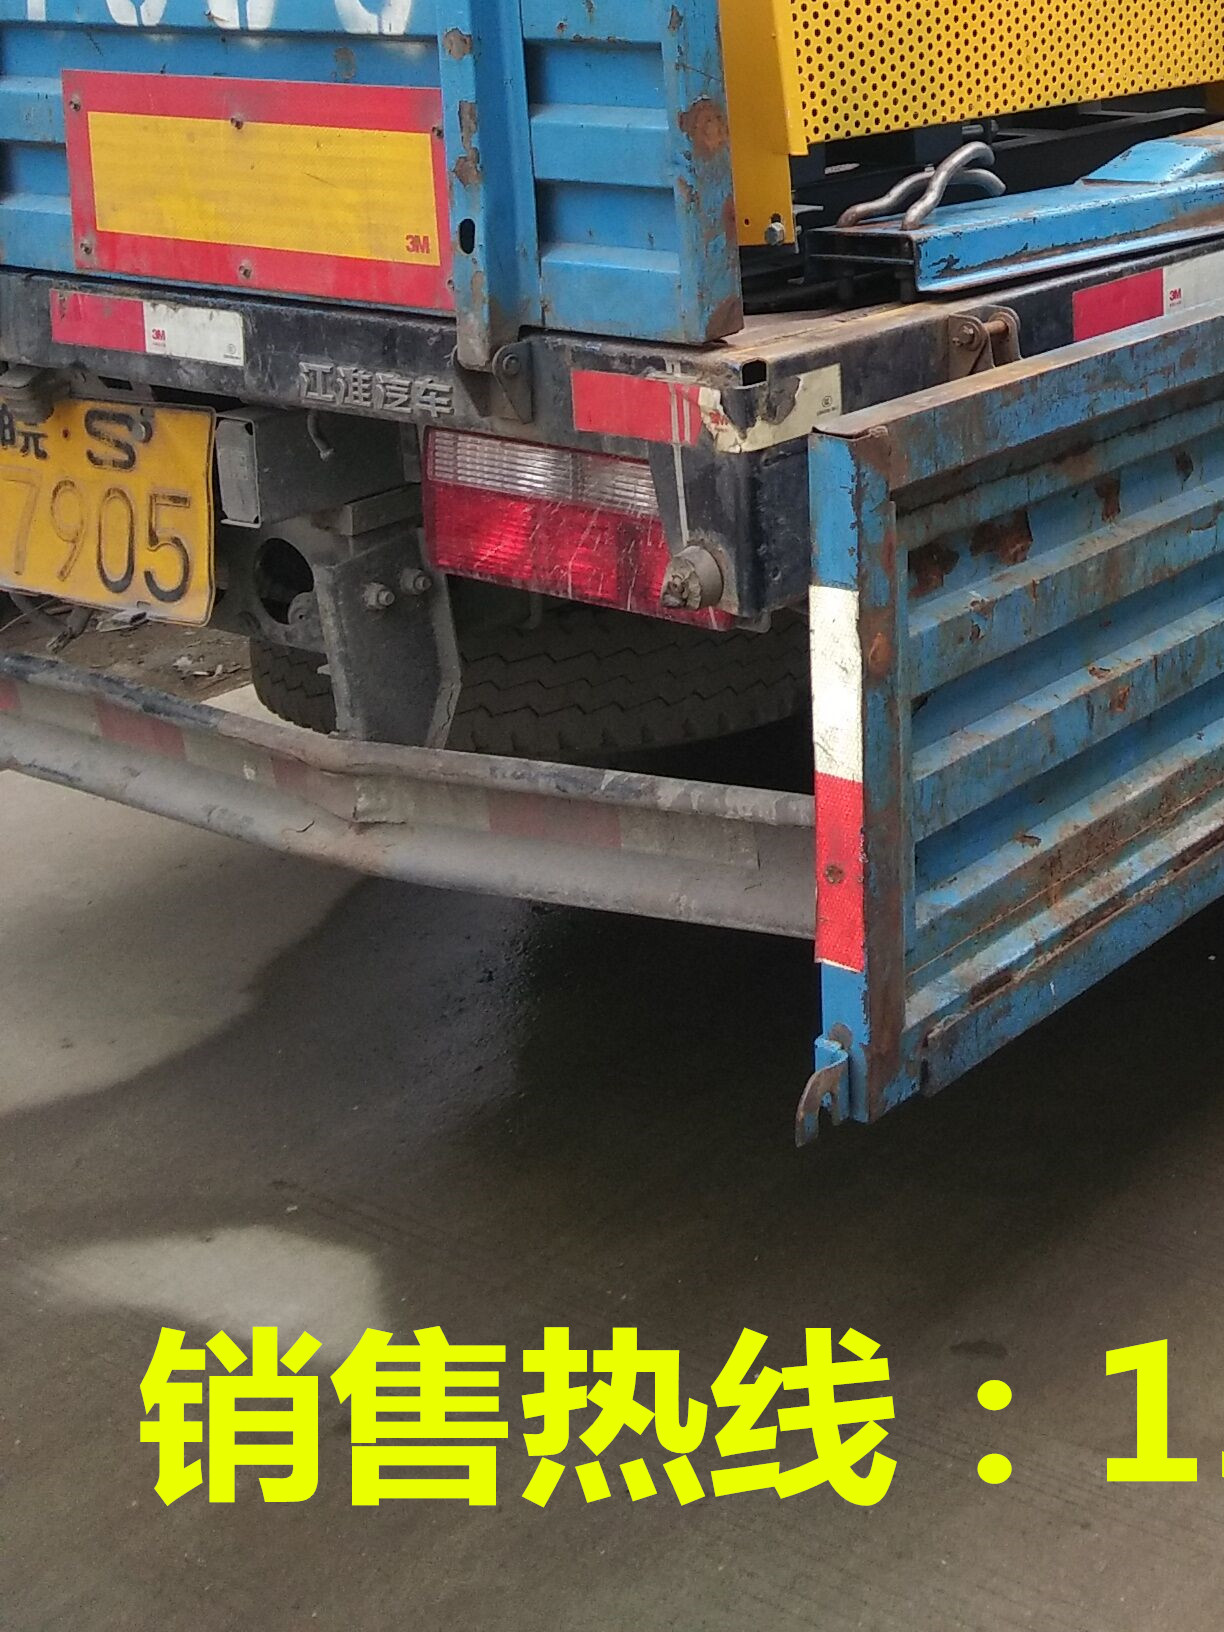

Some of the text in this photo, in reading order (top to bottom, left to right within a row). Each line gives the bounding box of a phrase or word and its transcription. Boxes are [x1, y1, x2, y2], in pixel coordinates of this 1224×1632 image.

[405, 234, 430, 254] 3M
[1169, 288, 1182, 302] 3M
[151, 328, 166, 341] 3M
[299, 361, 454, 418] 江淮汽车
